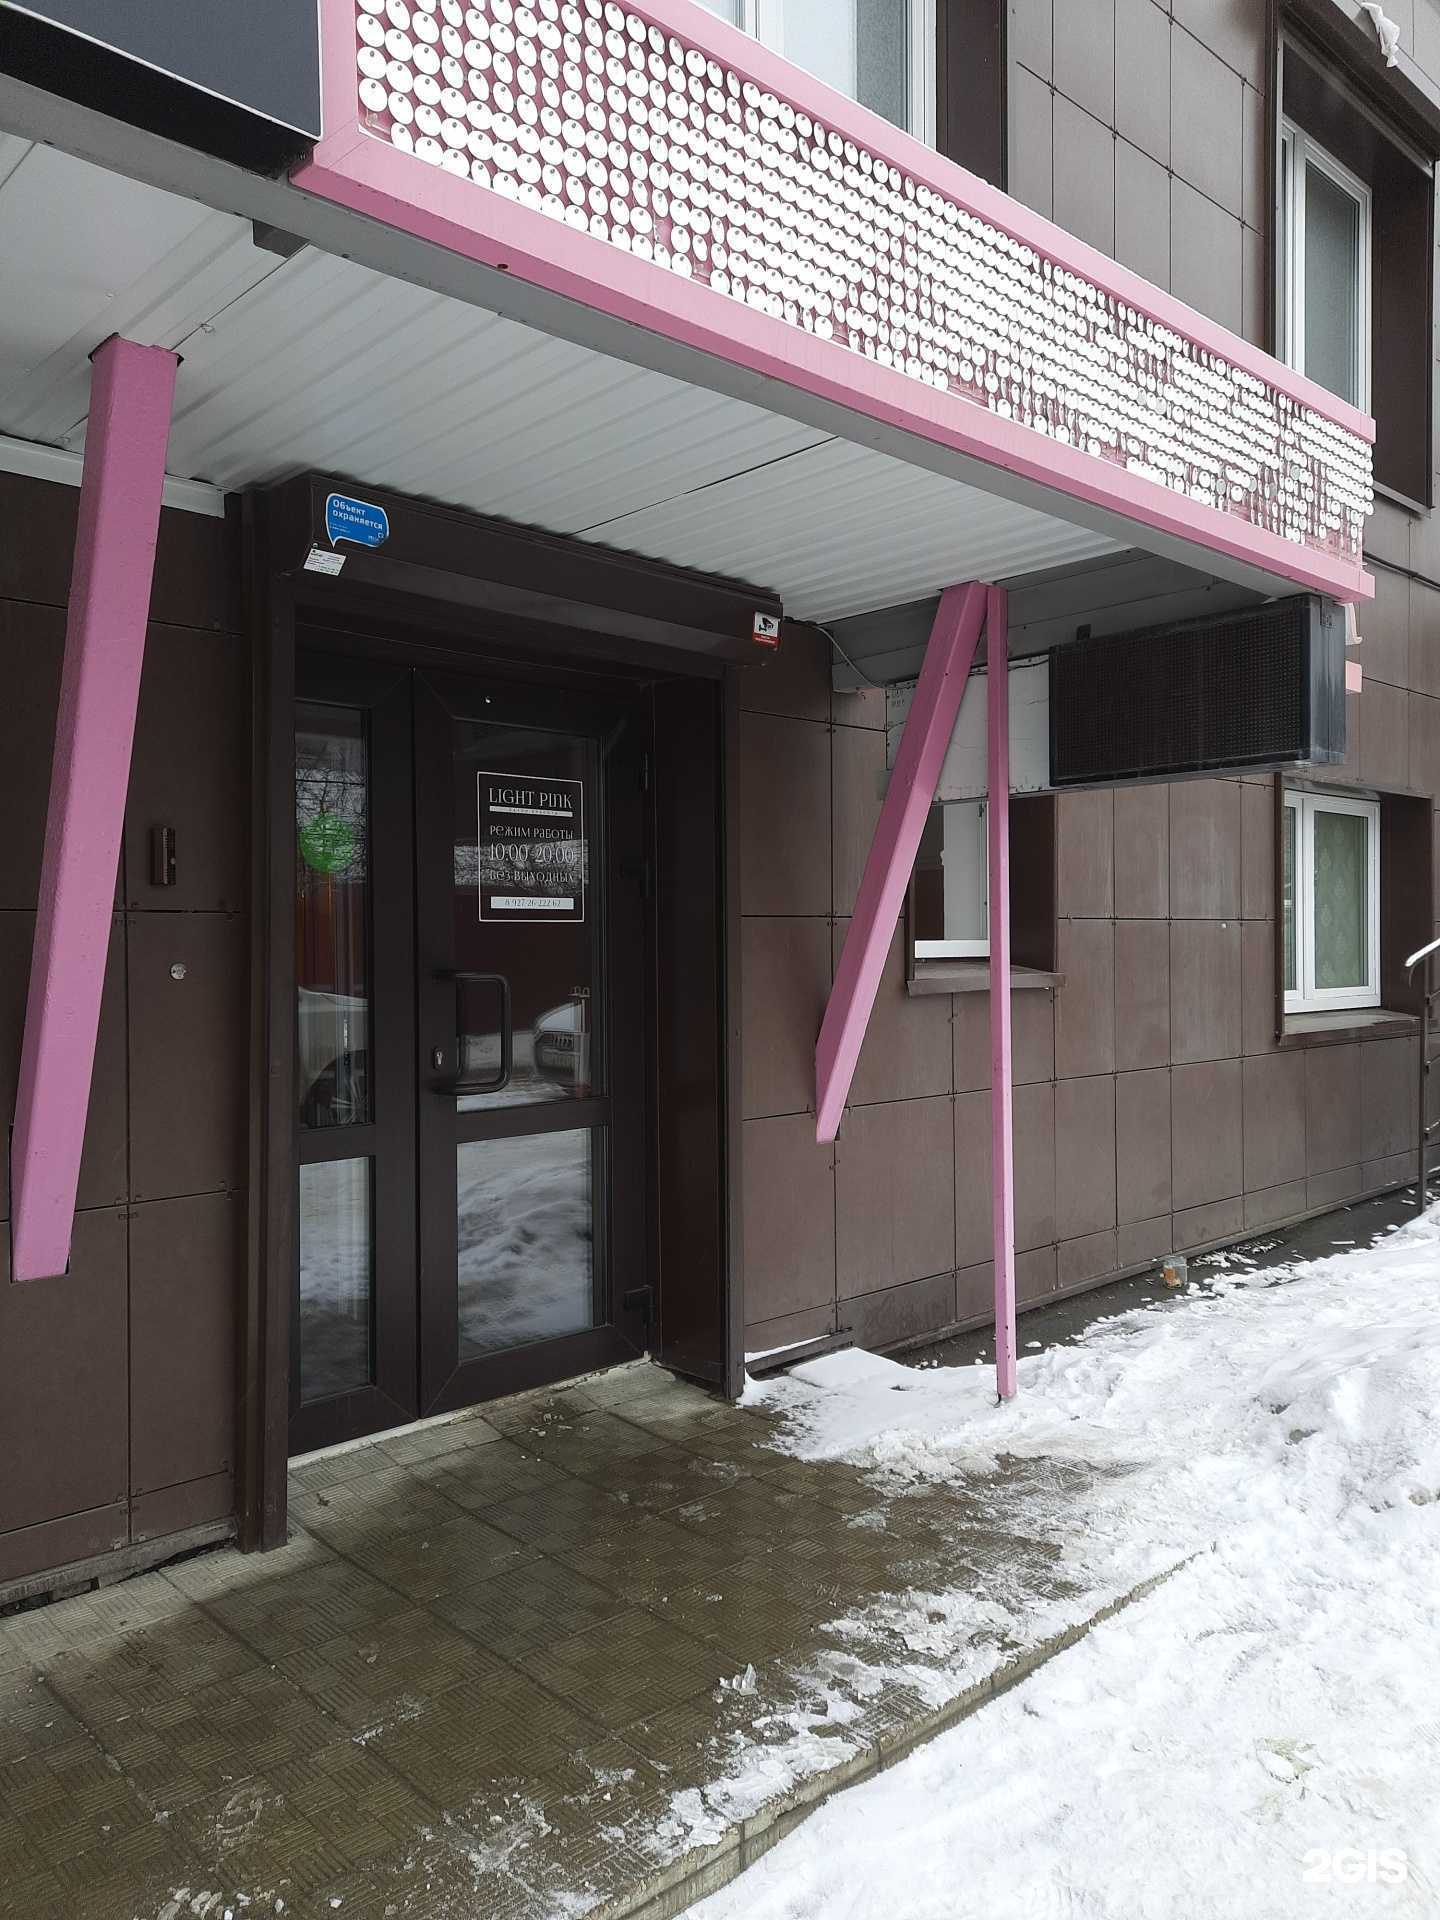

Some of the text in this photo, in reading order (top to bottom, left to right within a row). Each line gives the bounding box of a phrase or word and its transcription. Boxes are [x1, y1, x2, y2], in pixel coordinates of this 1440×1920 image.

[333, 499, 366, 516] Объект
[332, 509, 383, 530] охраняется
[489, 787, 535, 806] LIGHT
